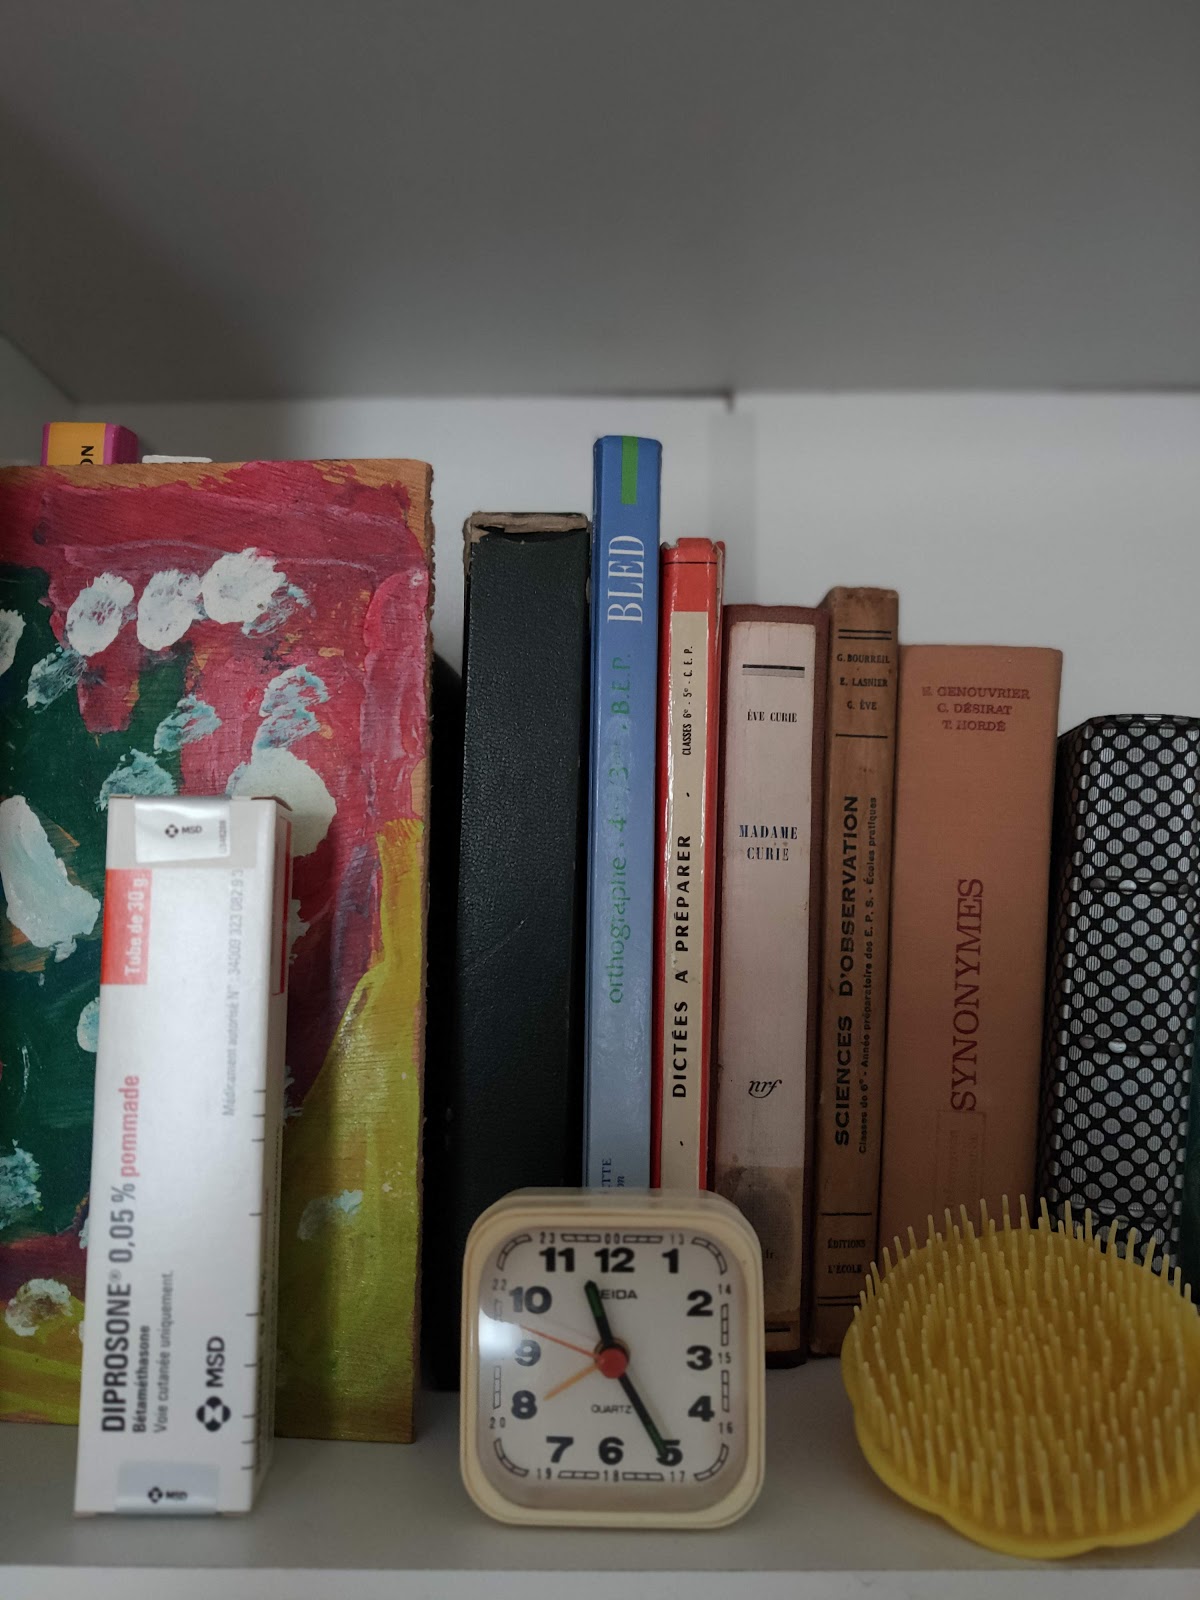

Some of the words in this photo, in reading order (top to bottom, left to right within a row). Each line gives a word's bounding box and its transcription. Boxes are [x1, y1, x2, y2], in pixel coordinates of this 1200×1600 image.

[607, 534, 644, 624] BLED
[847, 654, 890, 664] BOURREIL
[852, 678, 888, 687] LASNIER
[937, 686, 1030, 700] GENOUVRIER
[770, 711, 798, 723] CURIE
[937, 703, 949, 713] C.
[954, 702, 1013, 715] DÉSIRAT
[942, 720, 953, 730] T.
[956, 720, 1006, 732] HORDÉ
[682, 724, 692, 756] CLASSES
[181, 825, 203, 835] MSD
[739, 824, 798, 840] MADAME
[868, 797, 877, 846] pratiques
[747, 847, 789, 861] CURIE
[863, 851, 875, 885] Écoles
[128, 890, 145, 911] 30
[674, 836, 691, 952] PRÉPARER
[839, 796, 858, 997] D'OBSERVATION
[126, 914, 143, 934] de
[607, 857, 632, 1005] orthographe
[124, 937, 142, 977] Tube
[864, 941, 873, 959] des
[675, 970, 688, 983] A
[862, 962, 873, 1030] préparatoire
[951, 878, 984, 1112] SYNONYMES
[225, 1003, 239, 1046] autorisé
[672, 1001, 688, 1098] DICTÉES
[861, 1034, 870, 1067] Année
[221, 1049, 237, 1117] Médicament
[835, 1016, 853, 1146] SCIENCES
[860, 1096, 868, 1108] de
[118, 1075, 141, 1178] pommade
[859, 1112, 868, 1153] Classes
[111, 1183, 136, 1203] %
[108, 1210, 136, 1264] 0,05
[670, 1233, 684, 1246] 13
[828, 1237, 866, 1248] ÉDITIONS
[539, 1246, 575, 1273] 11
[594, 1247, 635, 1273] 12
[662, 1248, 679, 1274] 1
[492, 1278, 507, 1291] 22
[718, 1284, 731, 1295] 14
[509, 1285, 553, 1314] 10
[686, 1289, 713, 1317] 2
[206, 1336, 226, 1388] MSD
[515, 1340, 541, 1367] 9
[686, 1345, 713, 1371] 3
[718, 1352, 731, 1364] 15
[132, 1325, 150, 1434] Bétaméthasone
[155, 1351, 171, 1402] cutanée
[511, 1390, 537, 1420] 8
[591, 1404, 632, 1414] QUARTZ
[688, 1395, 715, 1422] 4
[153, 1405, 168, 1434] Voie
[489, 1416, 506, 1429] 20
[718, 1421, 733, 1434] 16
[546, 1435, 574, 1463] 7
[598, 1436, 625, 1465] 6
[656, 1440, 683, 1467] 5
[537, 1467, 552, 1480] 19
[604, 1470, 619, 1482] 18
[670, 1470, 685, 1482] 17
